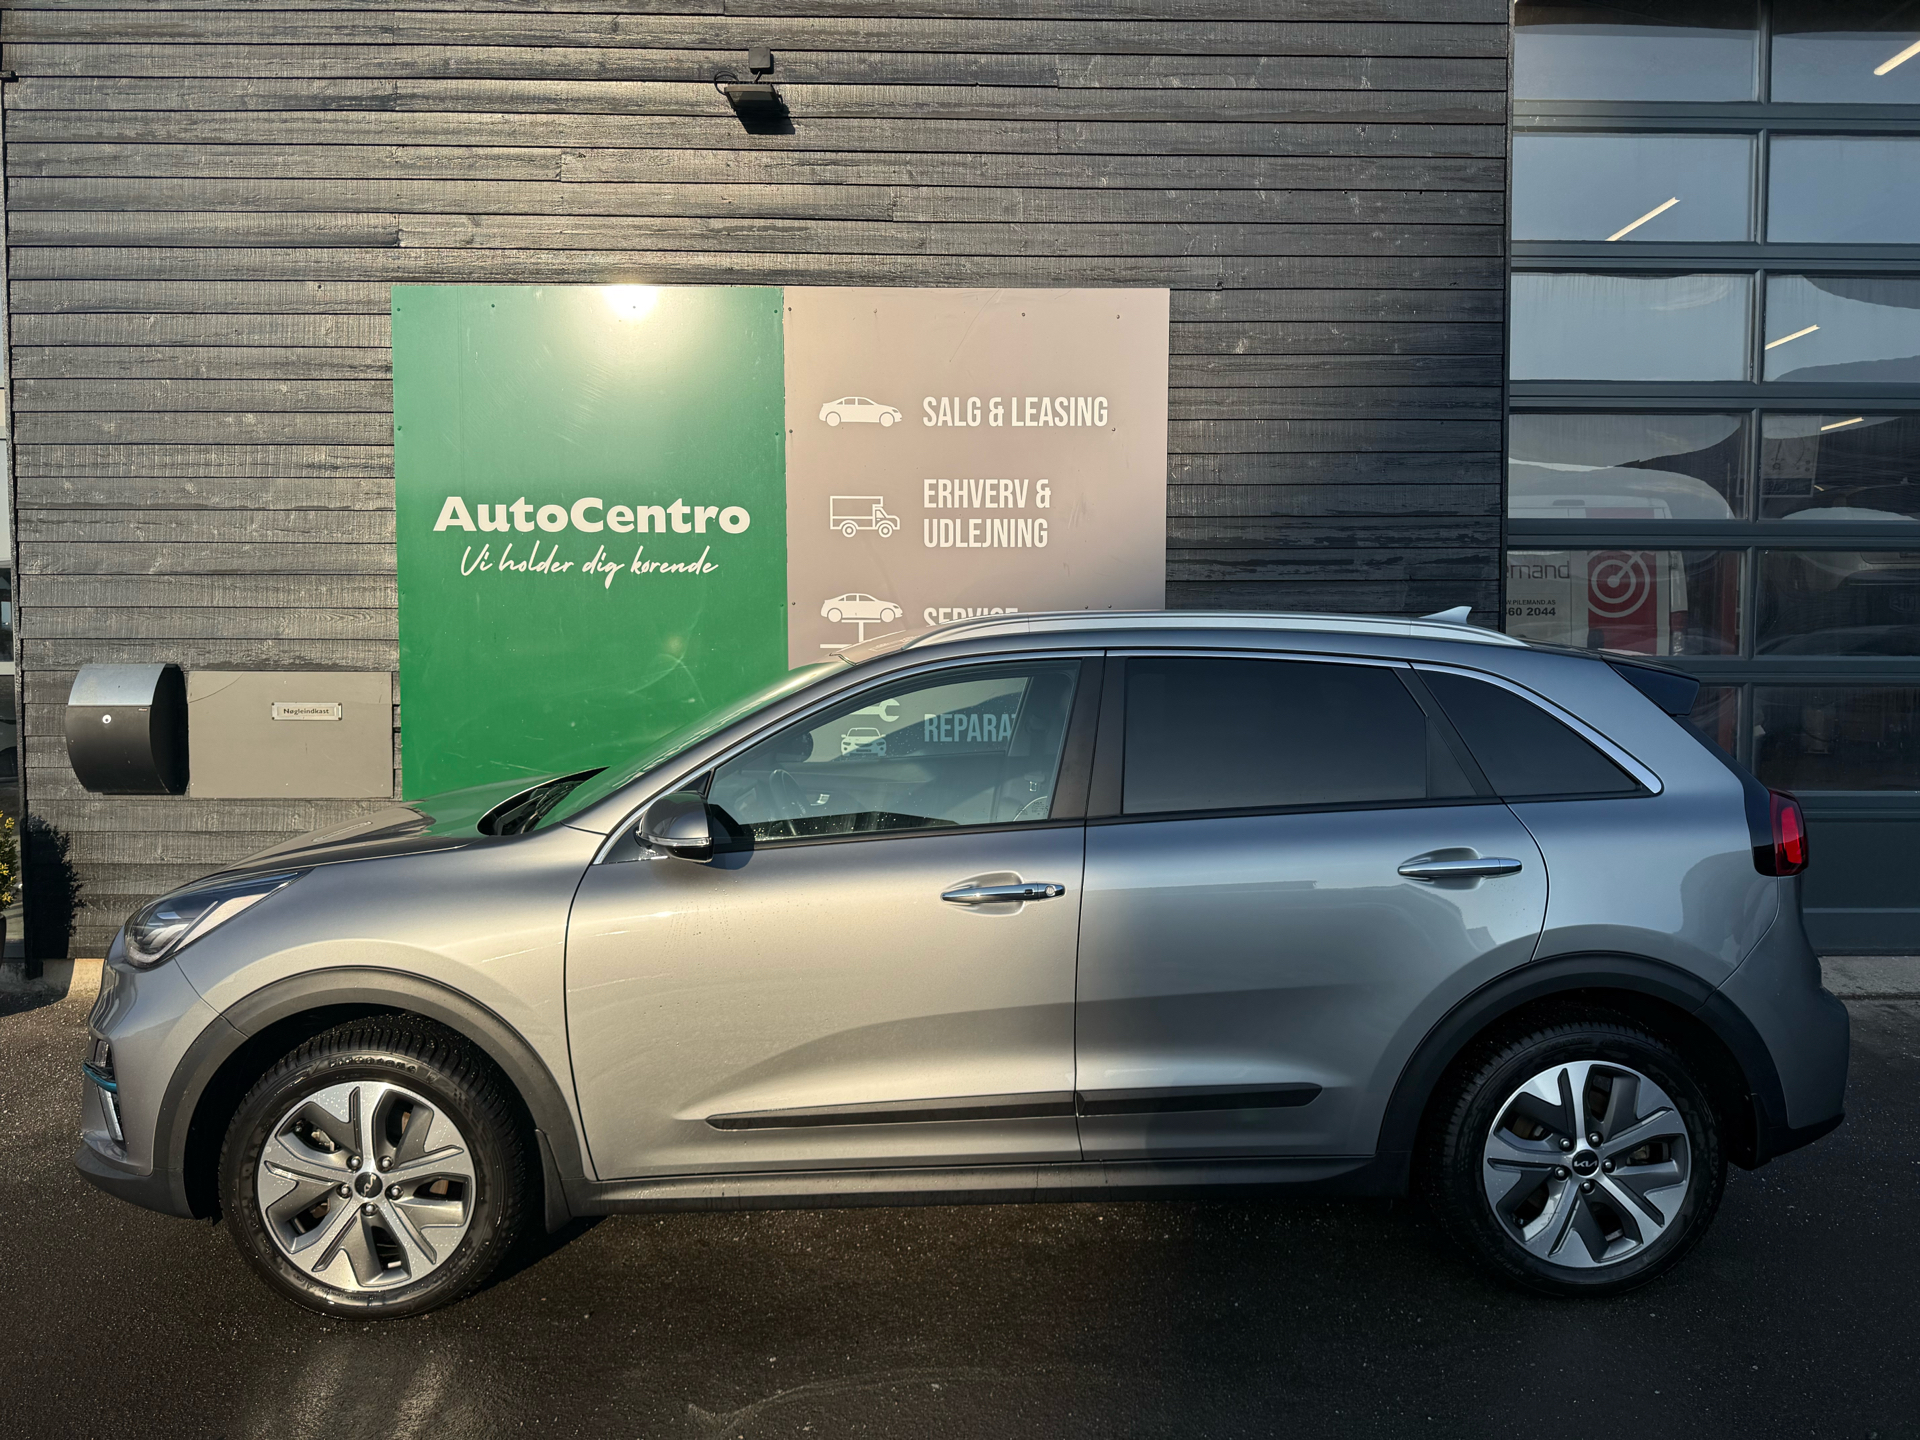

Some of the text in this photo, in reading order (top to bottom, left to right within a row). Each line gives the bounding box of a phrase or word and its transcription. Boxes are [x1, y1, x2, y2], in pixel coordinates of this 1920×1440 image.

[923, 396, 1108, 427] SALG & LEASING
[923, 479, 1052, 508] ERHVERV &
[432, 496, 751, 534] AutoCentro
[923, 518, 1048, 548] UDLEJNING
[460, 540, 719, 589] Vi holder dig kørende
[1506, 561, 1570, 579] mand
[1506, 607, 1556, 616] 60 2044
[283, 707, 330, 716] Nøgleindkast
[924, 714, 1016, 742] REPARA
